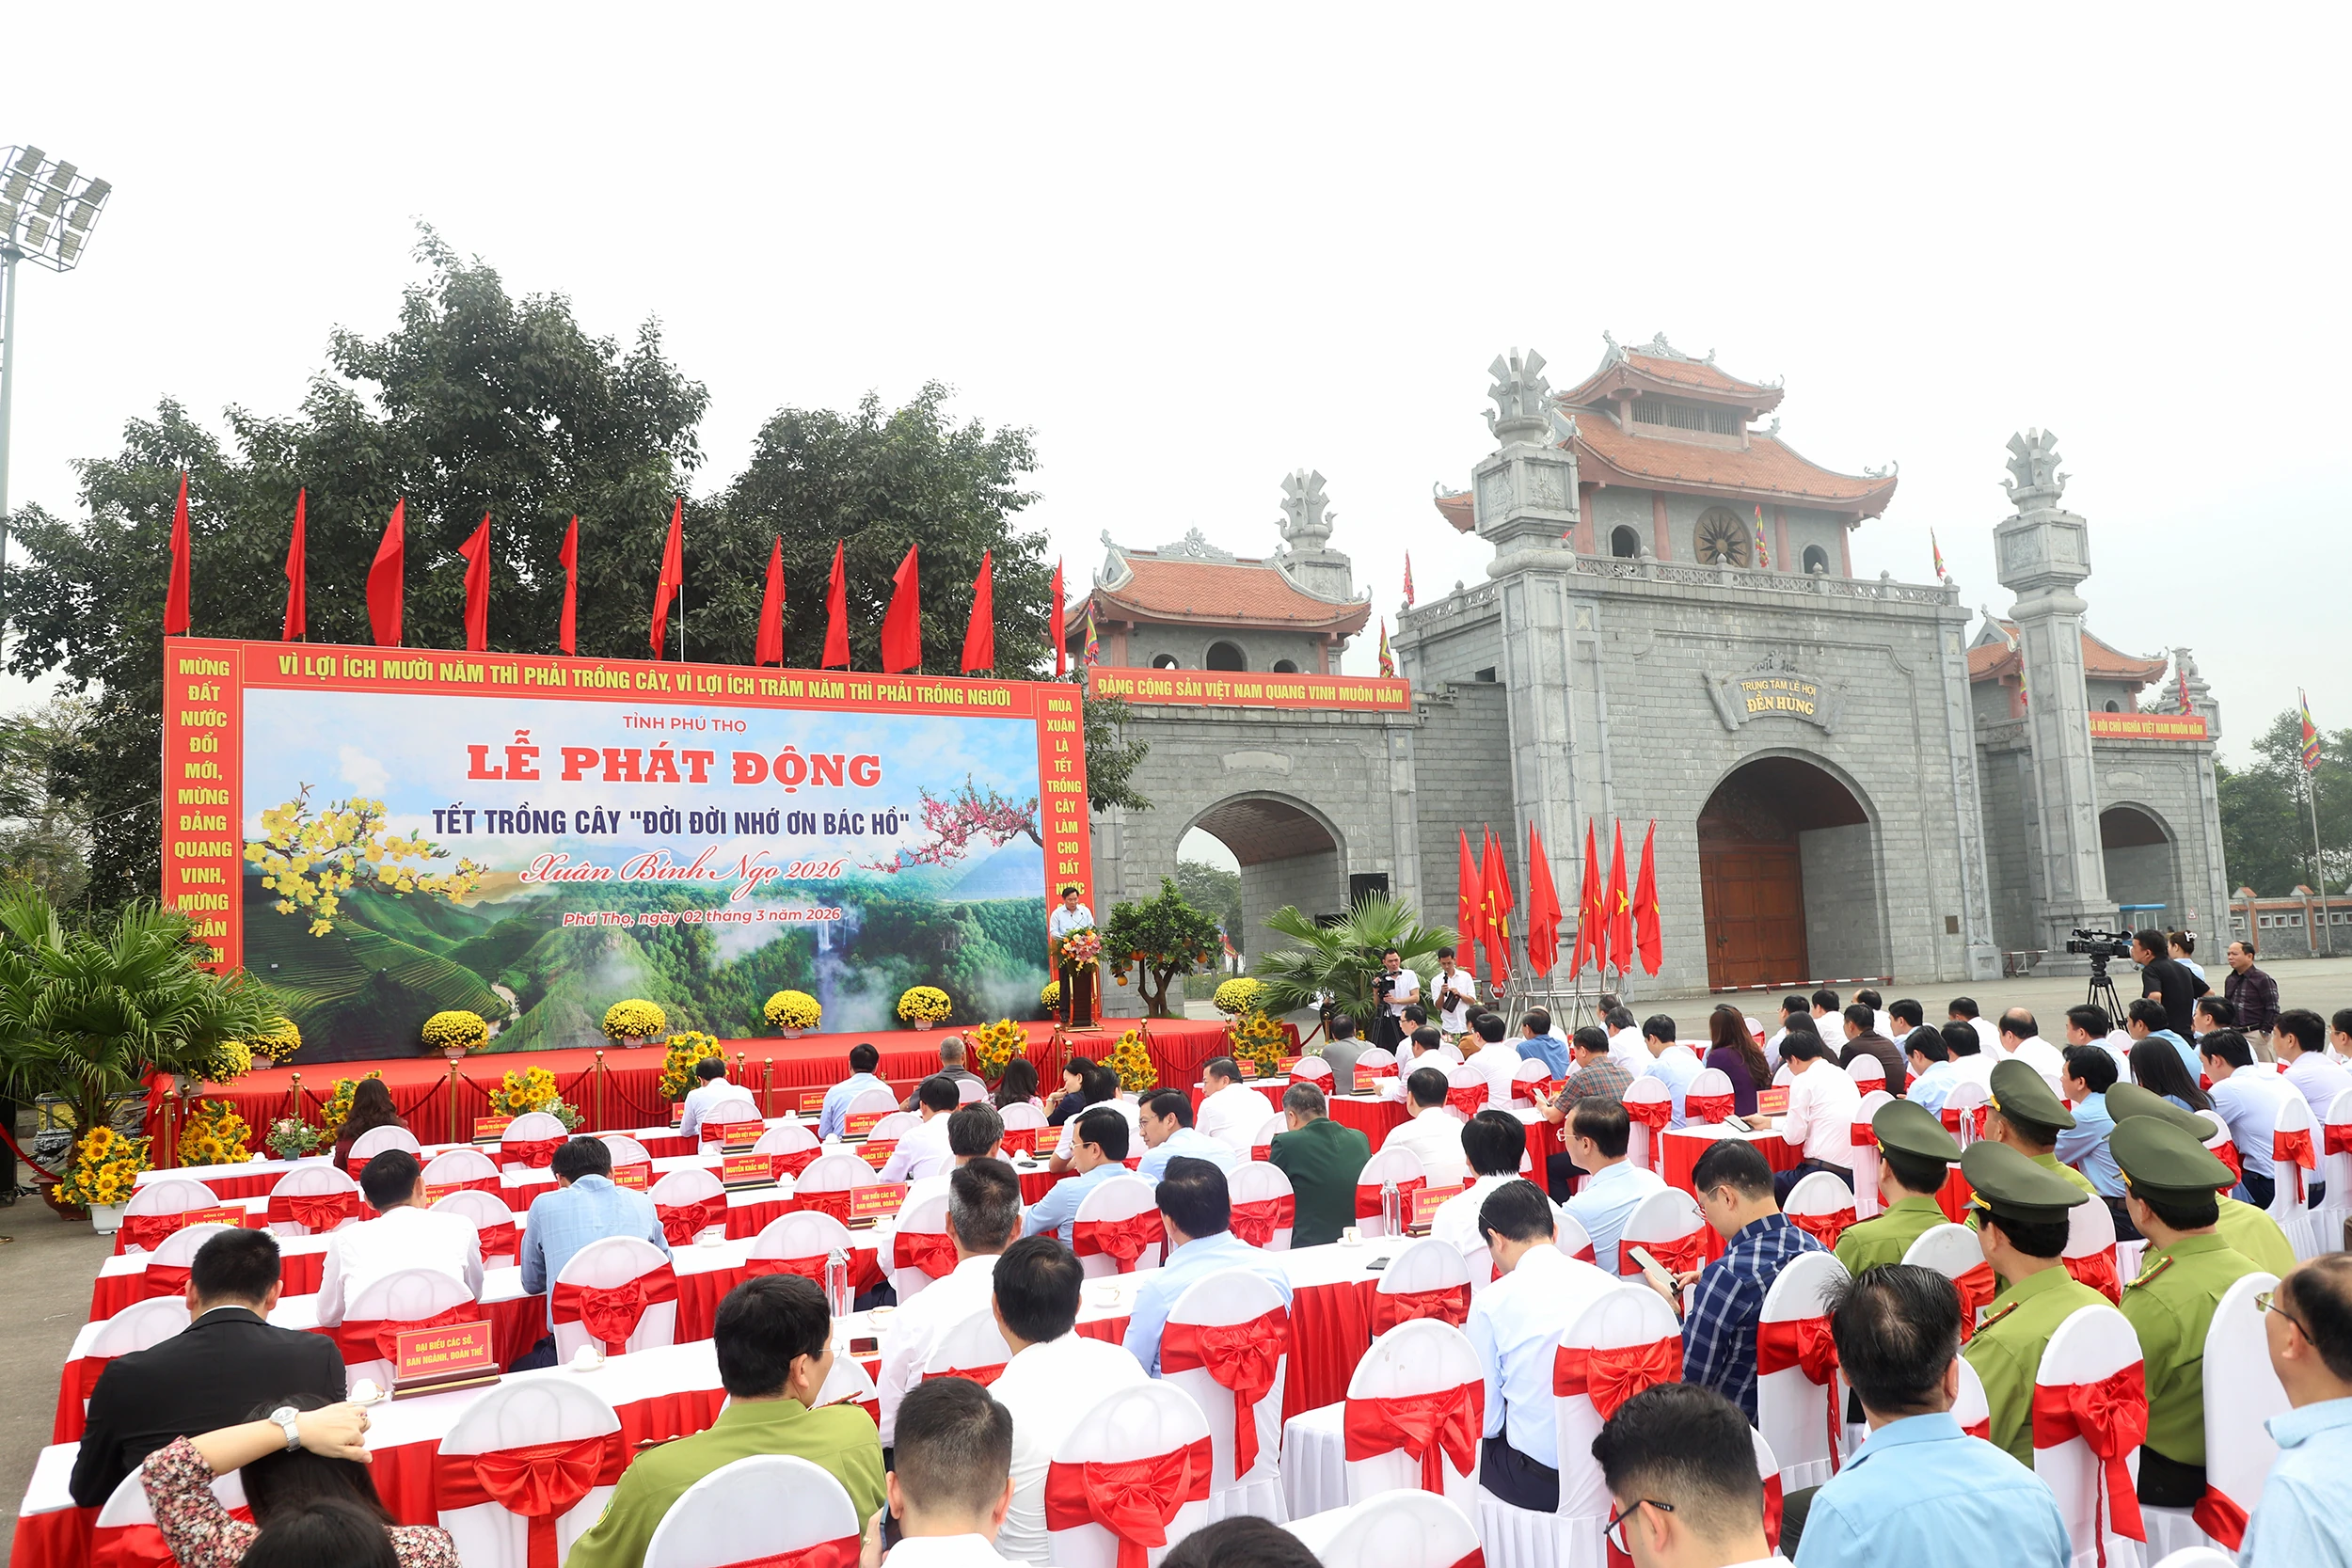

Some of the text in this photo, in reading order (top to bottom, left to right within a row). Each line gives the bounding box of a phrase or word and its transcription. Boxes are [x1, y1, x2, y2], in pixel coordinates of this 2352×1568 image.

[180, 657, 230, 676] MỪNG
[278, 652, 1011, 706] VÌ LỢI ÍCH MƯỜI NĂM THÌ PHẢI TRỒNG CÂY, VÌ LỢI ÍCH TRĂM NĂM THÌ PHẢI TRỒNG NGƯỜI
[1098, 673, 1403, 703] ĐẢNG CỘNG SẢN VIỆT NAM QUANG VINH MUÔN NĂM
[1740, 680, 1769, 692] TRUNG
[1772, 678, 1788, 690] TÂM
[188, 681, 220, 701] ĐẤT
[1048, 697, 1073, 712] MÙA
[1747, 691, 1814, 716] ĐỀN HÙNG
[181, 708, 228, 727] NƯỚC
[623, 712, 747, 736] TỈNH PHÚ THỌ
[1047, 718, 1076, 732] XUÂN
[190, 732, 218, 752] ĐỔI
[1056, 737, 1069, 752] LÀ
[468, 729, 882, 793] LỄ PHÁT ĐỘNG
[1055, 756, 1072, 772] TẾT
[185, 761, 223, 781] MỚI,
[179, 786, 230, 805] MỪNG
[1056, 799, 1076, 813] CÂY
[180, 810, 227, 832] ĐẢNG
[433, 801, 910, 835] TẾT TRỒNG CÂY "ĐỜI ĐỜI NHỚ ƠN BÁC HỒ"
[1056, 818, 1078, 833] LÀM
[175, 842, 232, 860] QUANG
[1057, 842, 1079, 854] CHO
[521, 845, 849, 901] Xuân Bính Ngọ 2026
[1059, 858, 1079, 875] ĐẤT
[181, 868, 226, 885] VINH,
[178, 892, 229, 911] MỪNG
[187, 918, 227, 937] UÂN
[564, 909, 841, 928] Phú Thọ, ngày 02 tháng 3 năm 2026
[726, 1164, 744, 1173] NGUYỄN
[416, 1334, 474, 1353] ĐẠI BIỂU CÁC SỞ,
[406, 1344, 484, 1367] BAN NGÀNH, ĐOÀN THỂ
